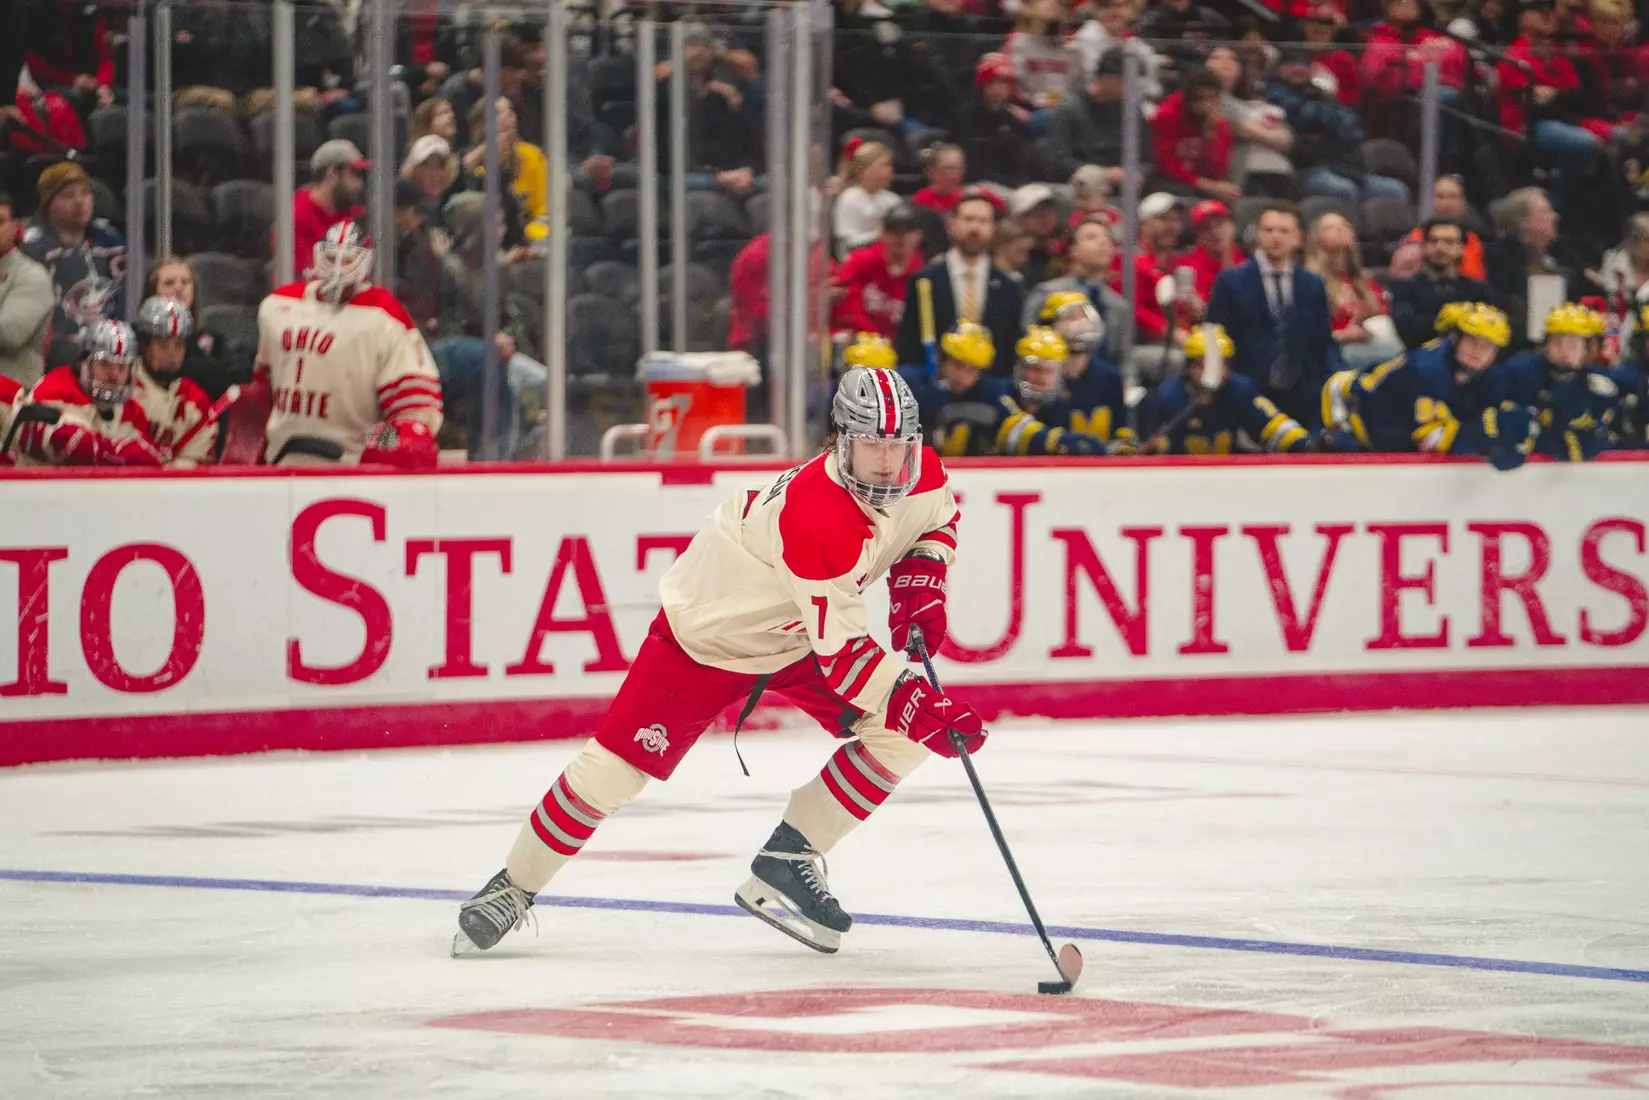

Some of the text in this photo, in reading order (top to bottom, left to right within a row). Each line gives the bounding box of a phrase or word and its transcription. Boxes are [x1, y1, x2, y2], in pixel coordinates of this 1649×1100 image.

[282, 328, 335, 355] OHIO
[938, 492, 1649, 664] UNIVERS
[811, 595, 828, 640] 7
